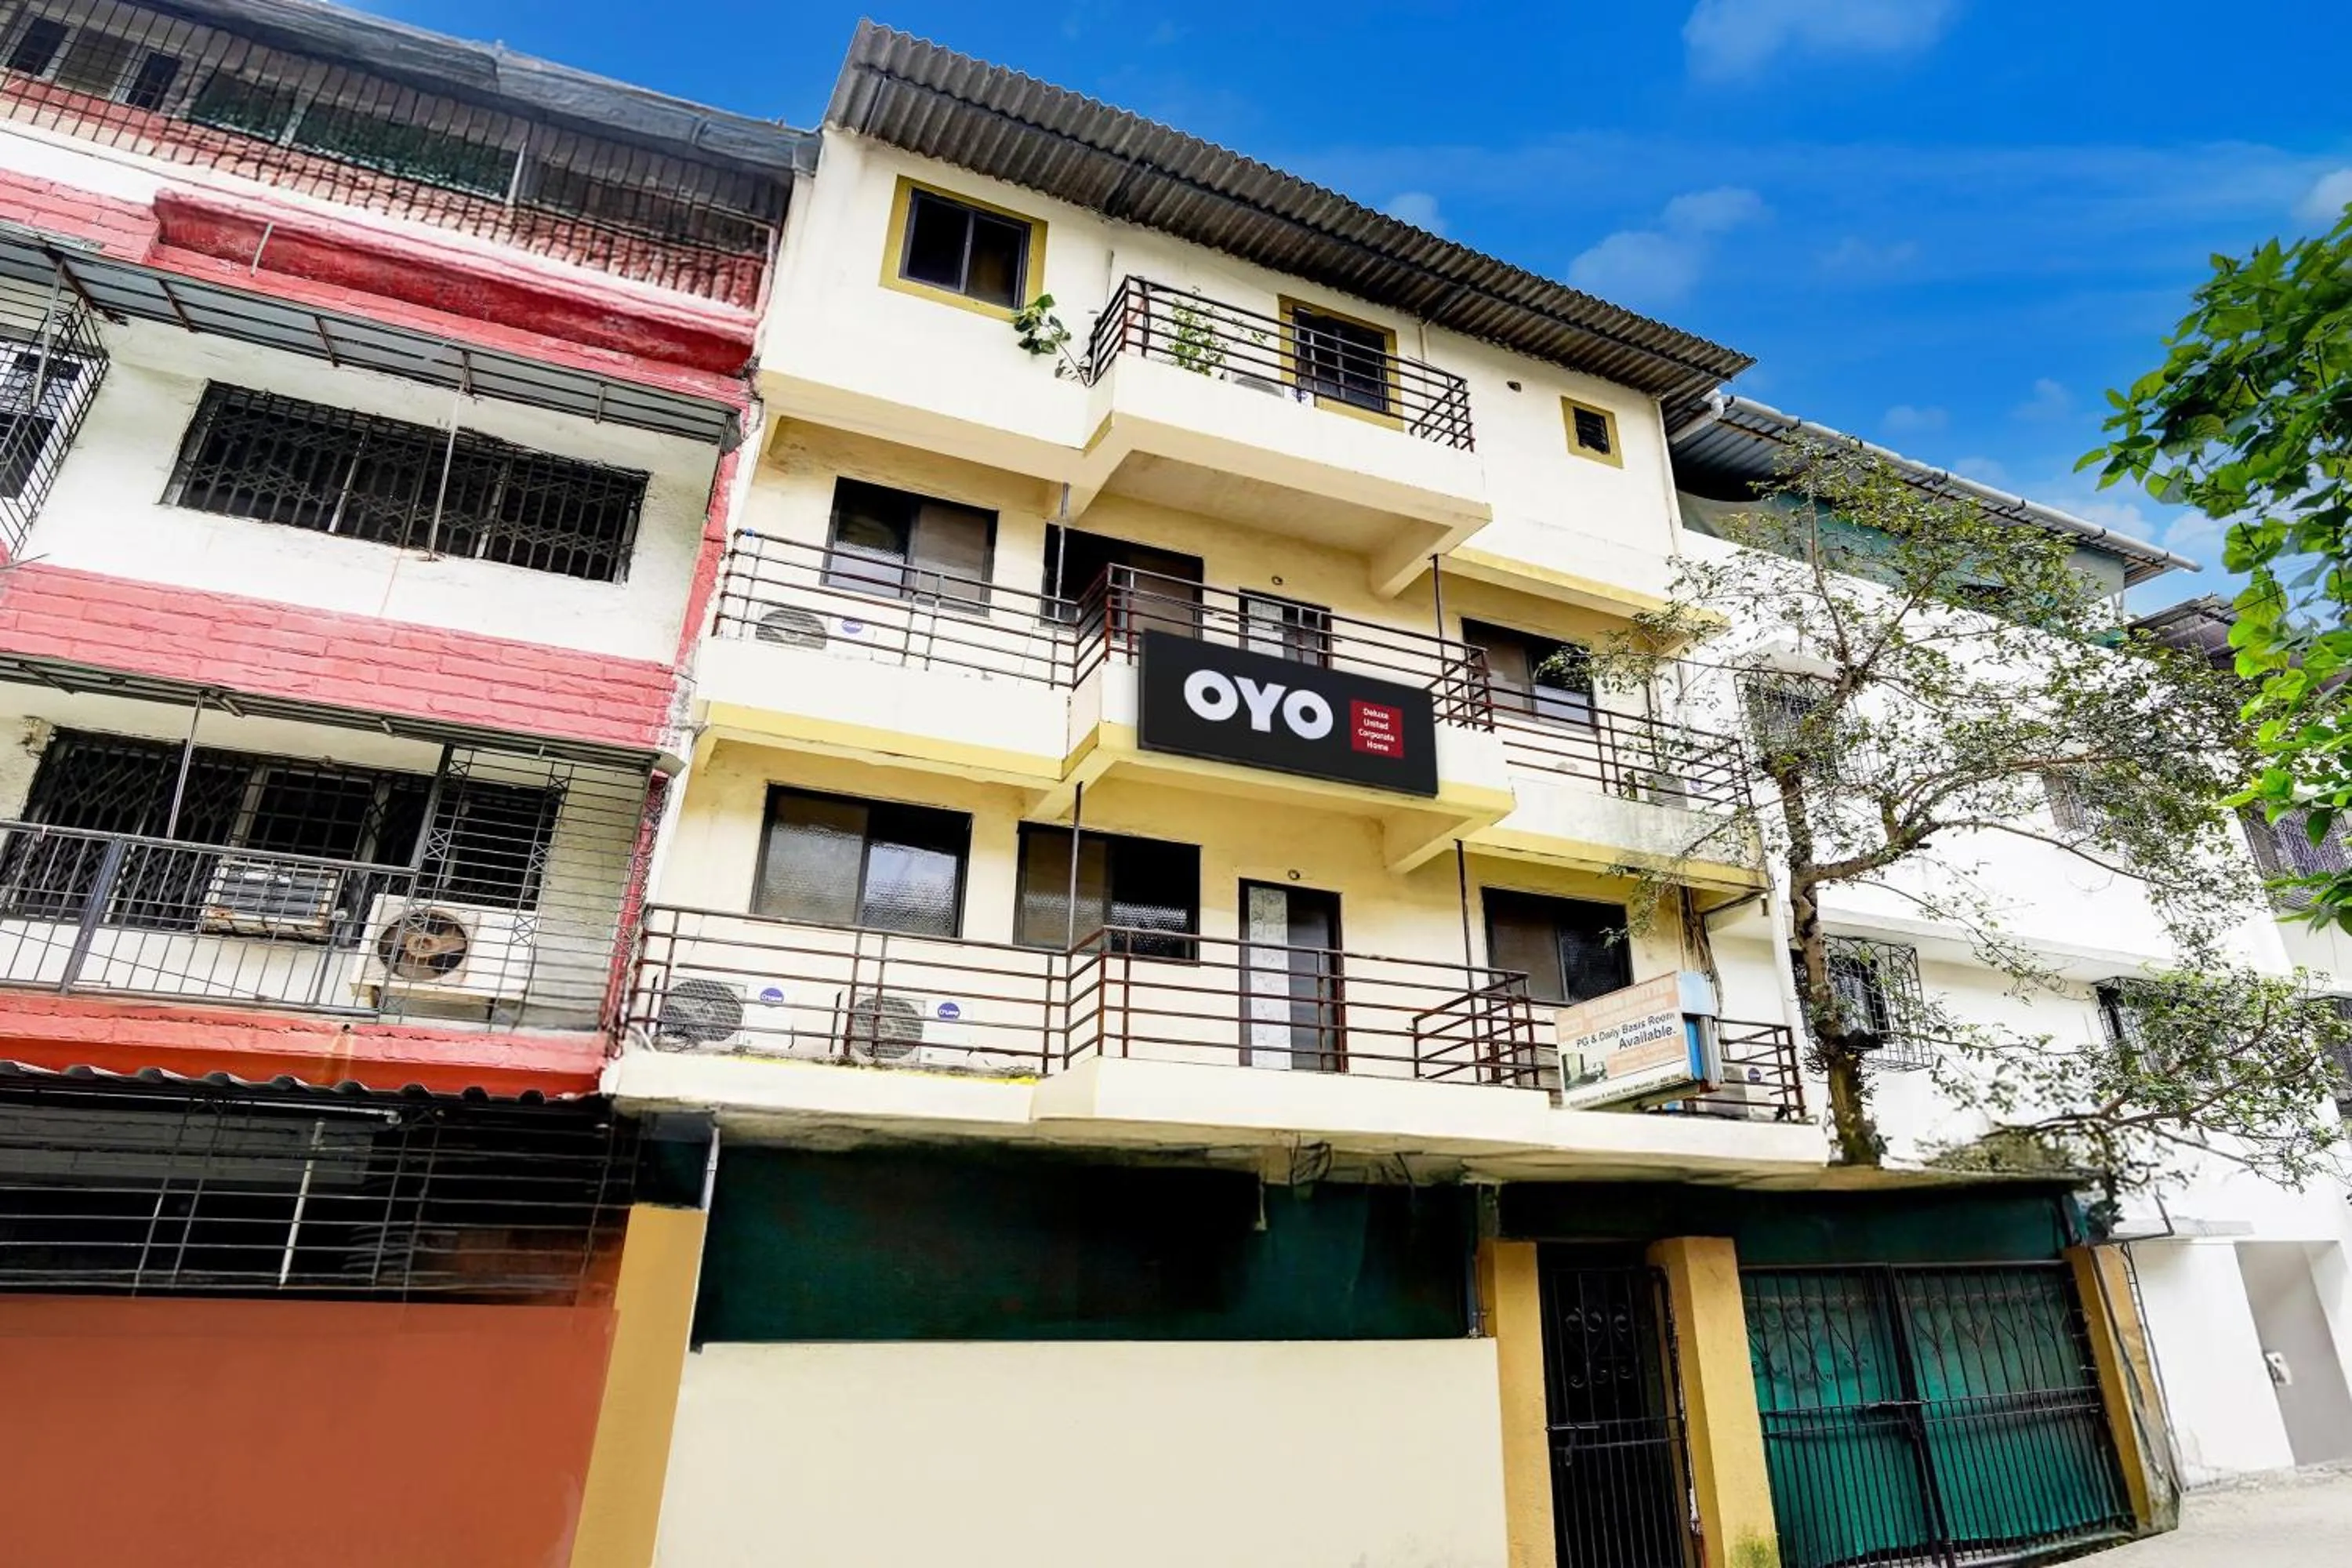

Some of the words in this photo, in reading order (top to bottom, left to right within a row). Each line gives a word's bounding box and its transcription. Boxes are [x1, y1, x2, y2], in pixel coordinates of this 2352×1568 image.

[1184, 670, 1333, 739] OYO
[1363, 707, 1388, 719] Deluxe
[1363, 718, 1388, 730] United
[1357, 728, 1395, 742] Corporate
[1367, 740, 1389, 752] Home
[1591, 1034, 1597, 1044] &
[1622, 1020, 1646, 1034] Basis
[1647, 1012, 1676, 1025] Room
